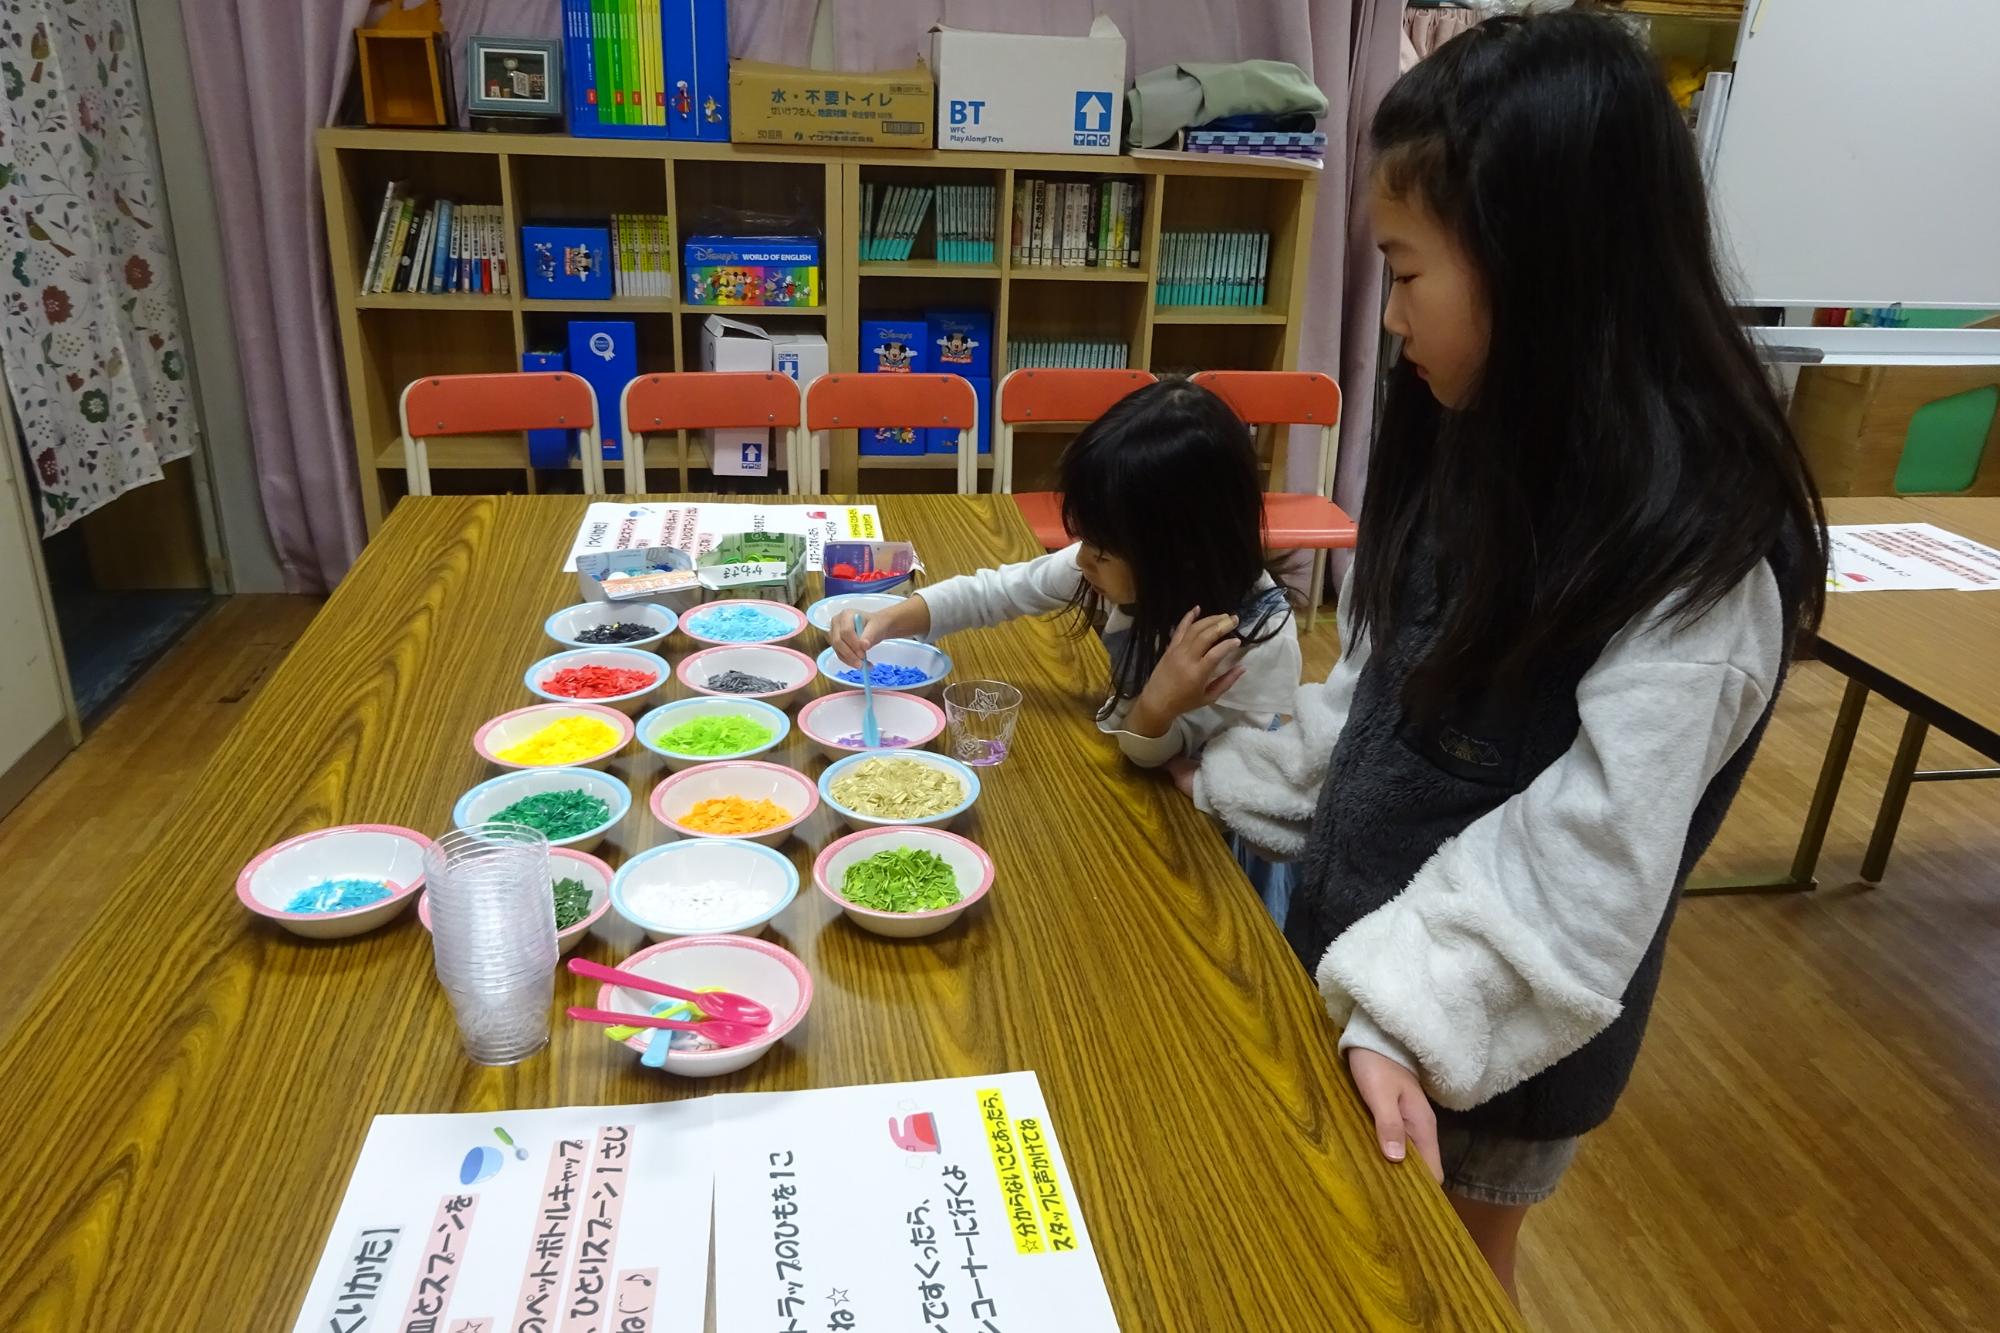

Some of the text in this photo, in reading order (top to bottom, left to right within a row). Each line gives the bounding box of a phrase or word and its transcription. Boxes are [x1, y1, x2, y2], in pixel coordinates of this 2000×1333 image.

[771, 88, 893, 107] 水・不要トイレ
[950, 100, 986, 125] BT
[950, 135, 965, 144] Play
[988, 136, 1004, 144] Toys
[742, 253, 770, 261] WORLD
[770, 253, 780, 261] OF
[781, 253, 812, 261] ENGLISH
[1020, 1118, 1074, 1250] スタッフに声かけてね
